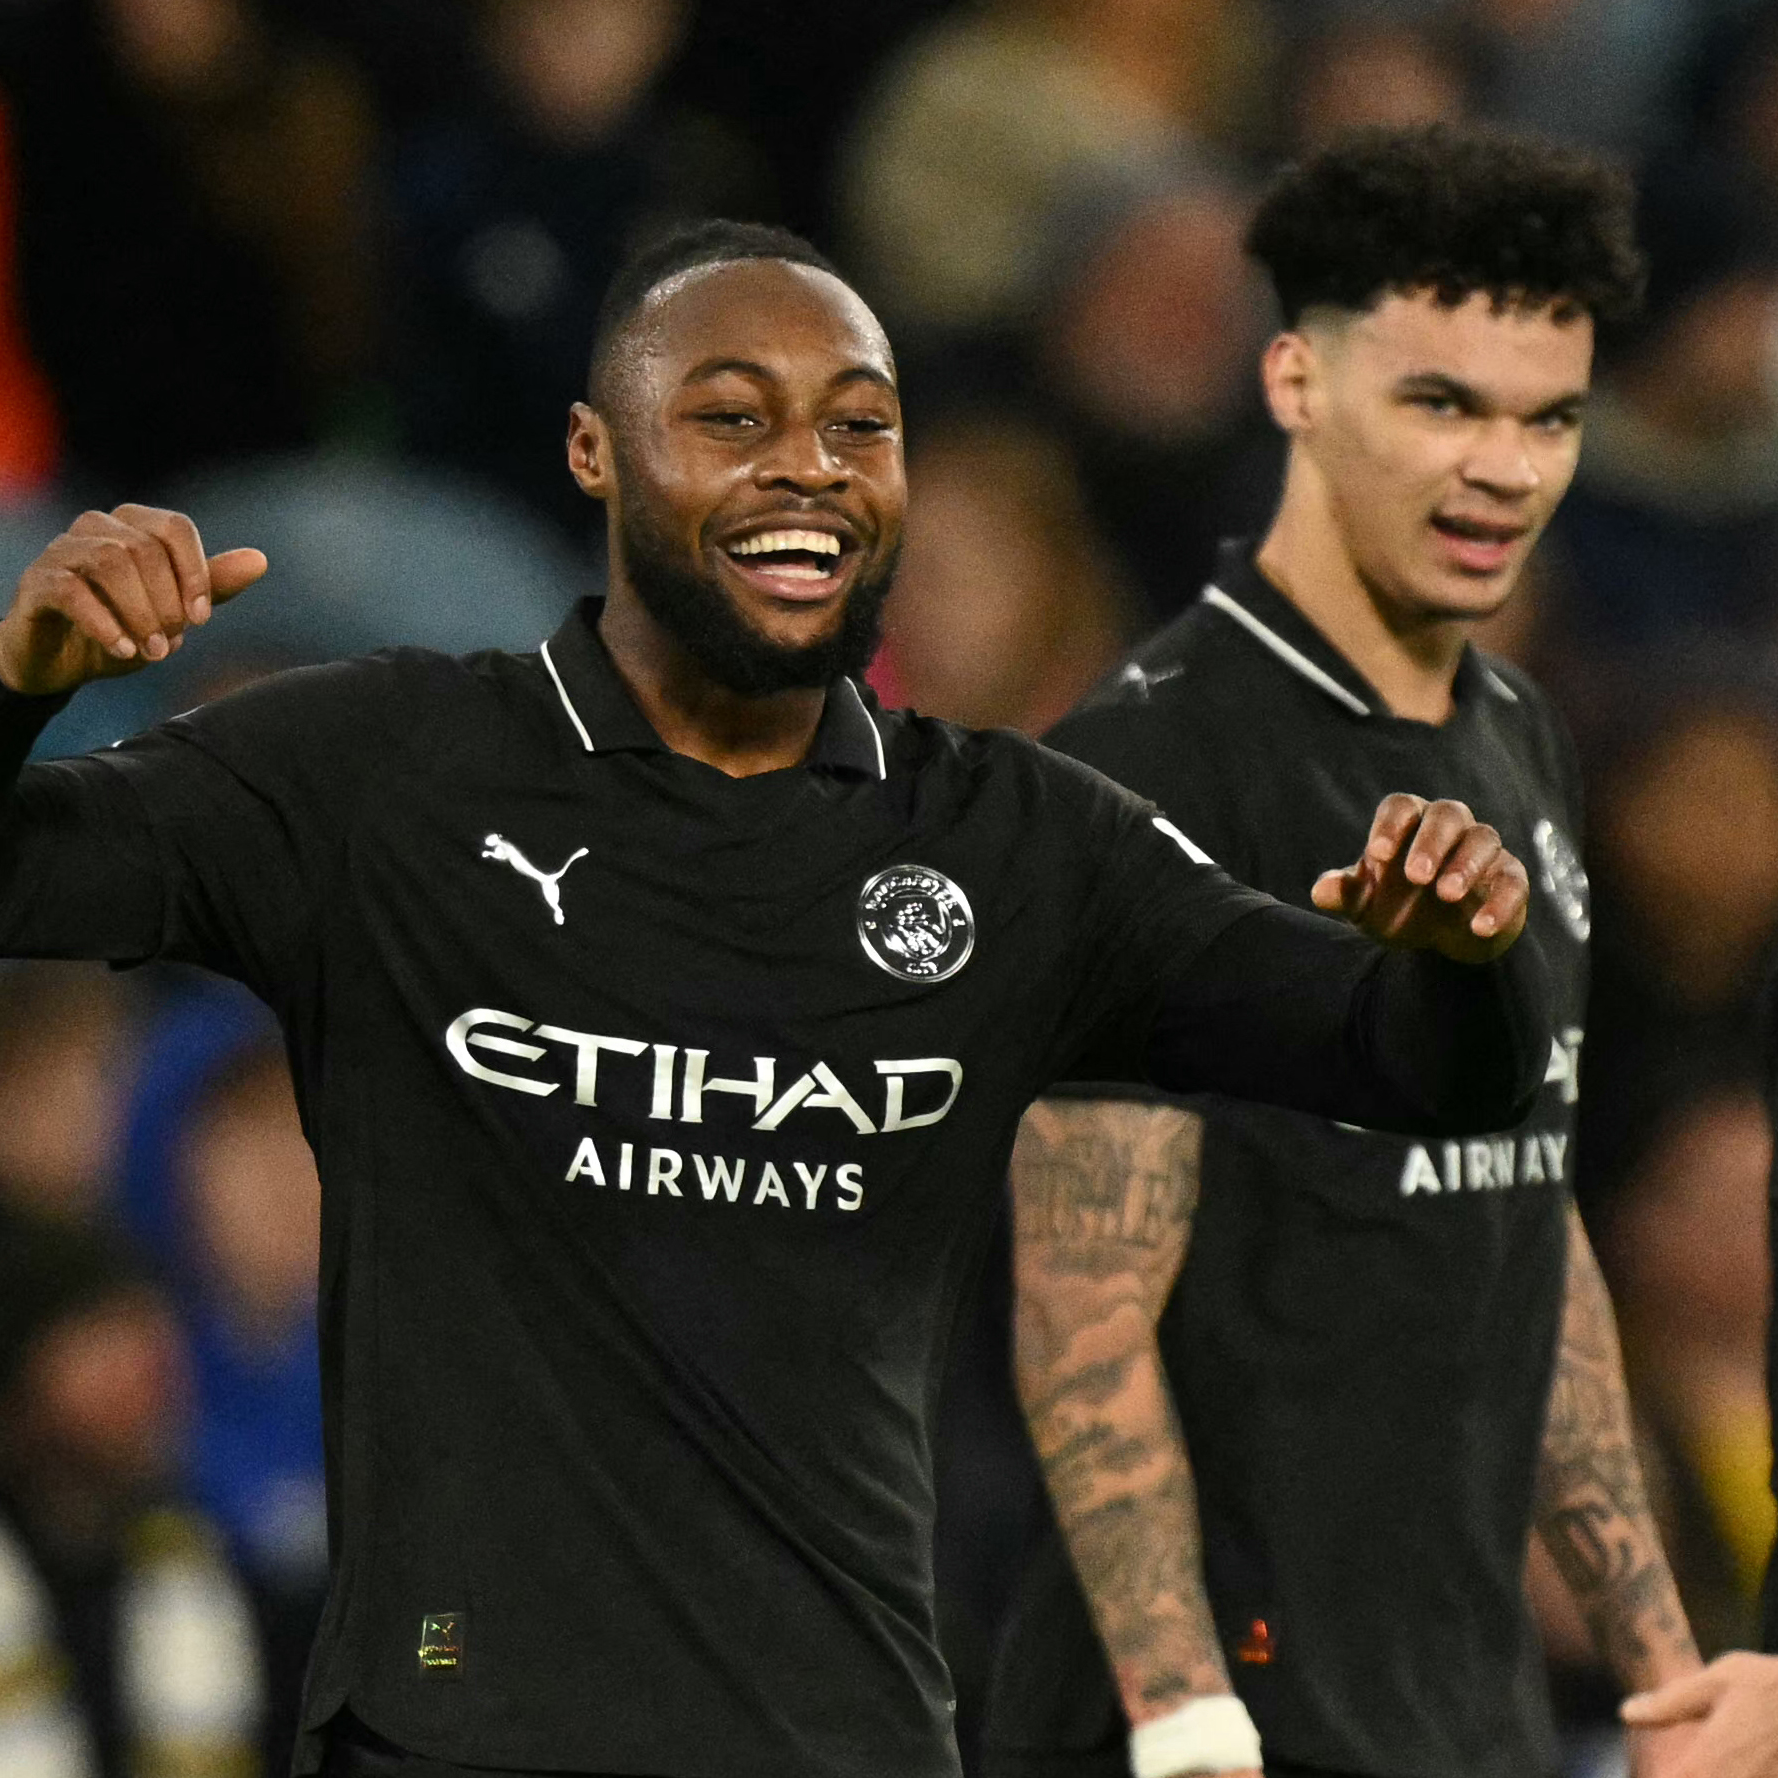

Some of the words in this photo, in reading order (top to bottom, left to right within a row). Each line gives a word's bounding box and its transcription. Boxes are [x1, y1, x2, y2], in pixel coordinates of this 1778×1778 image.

[445, 1007, 964, 1135] ETIHAD
[564, 1136, 864, 1212] AIRWAYS
[1399, 1131, 1569, 1197] AIRWAY
